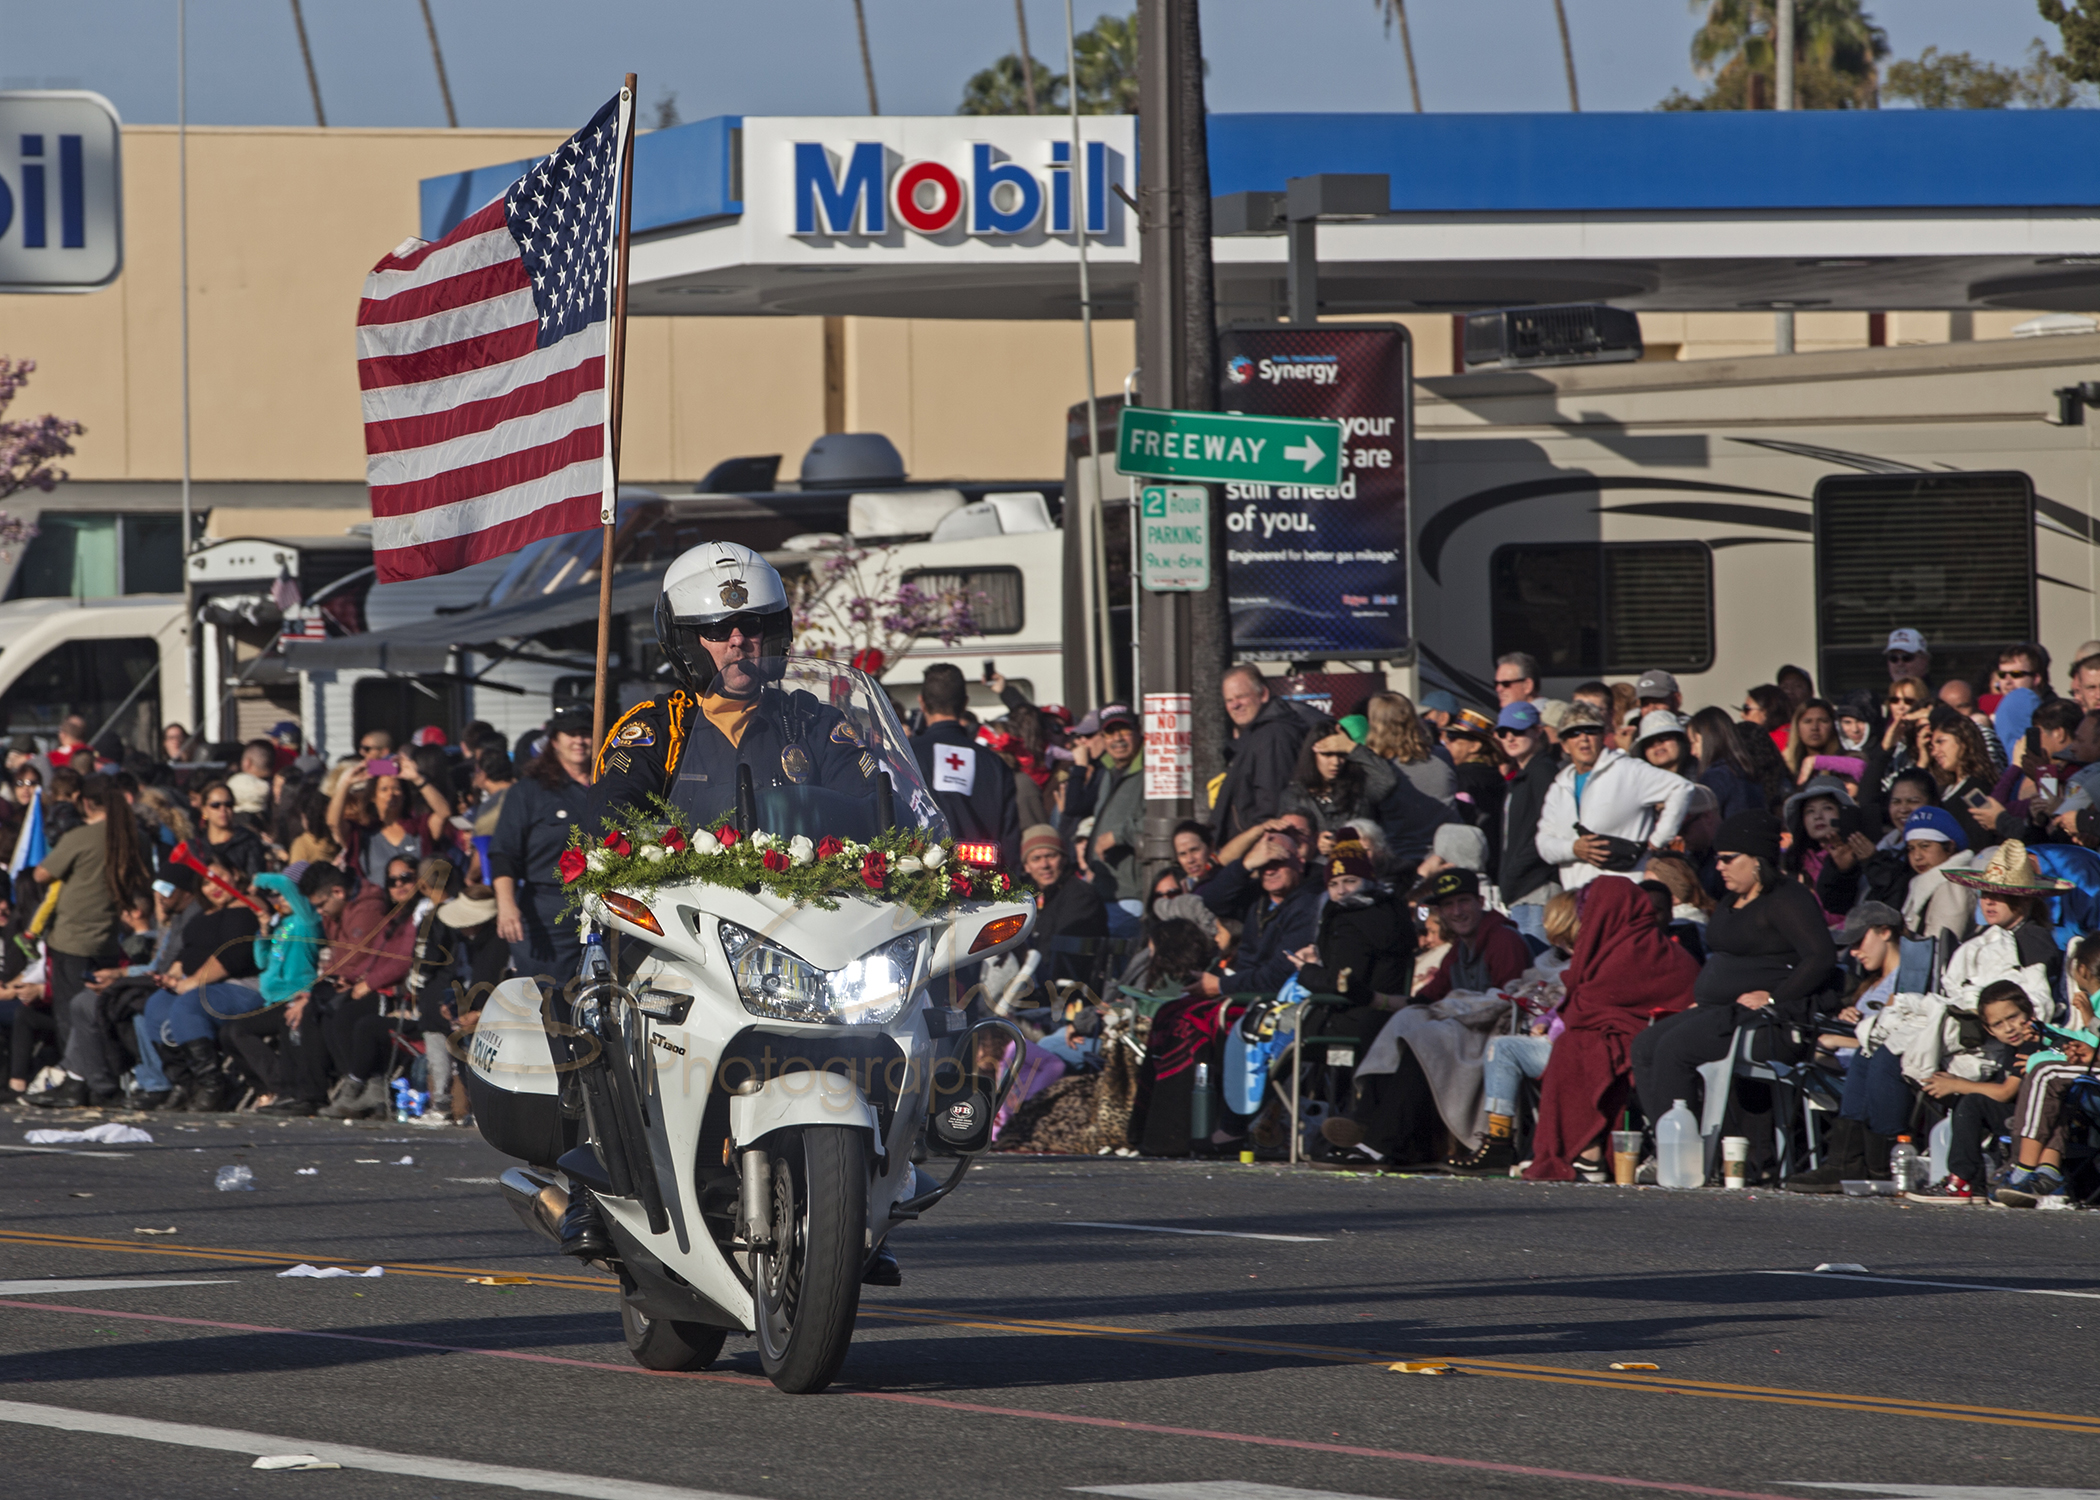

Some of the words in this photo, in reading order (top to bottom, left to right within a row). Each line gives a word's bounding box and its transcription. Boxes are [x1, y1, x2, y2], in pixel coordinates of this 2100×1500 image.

[0, 134, 86, 250] il
[793, 141, 1108, 234] Mobil
[1258, 359, 1338, 385] Synergy
[1129, 428, 1267, 464] FREEWAY
[1353, 448, 1393, 468] are
[1146, 491, 1163, 514] 2
[1170, 497, 1202, 514] HOUR
[1226, 504, 1258, 533] of
[1260, 511, 1317, 539] you.
[1148, 526, 1203, 545] PARKING
[1157, 715, 1177, 730] NO
